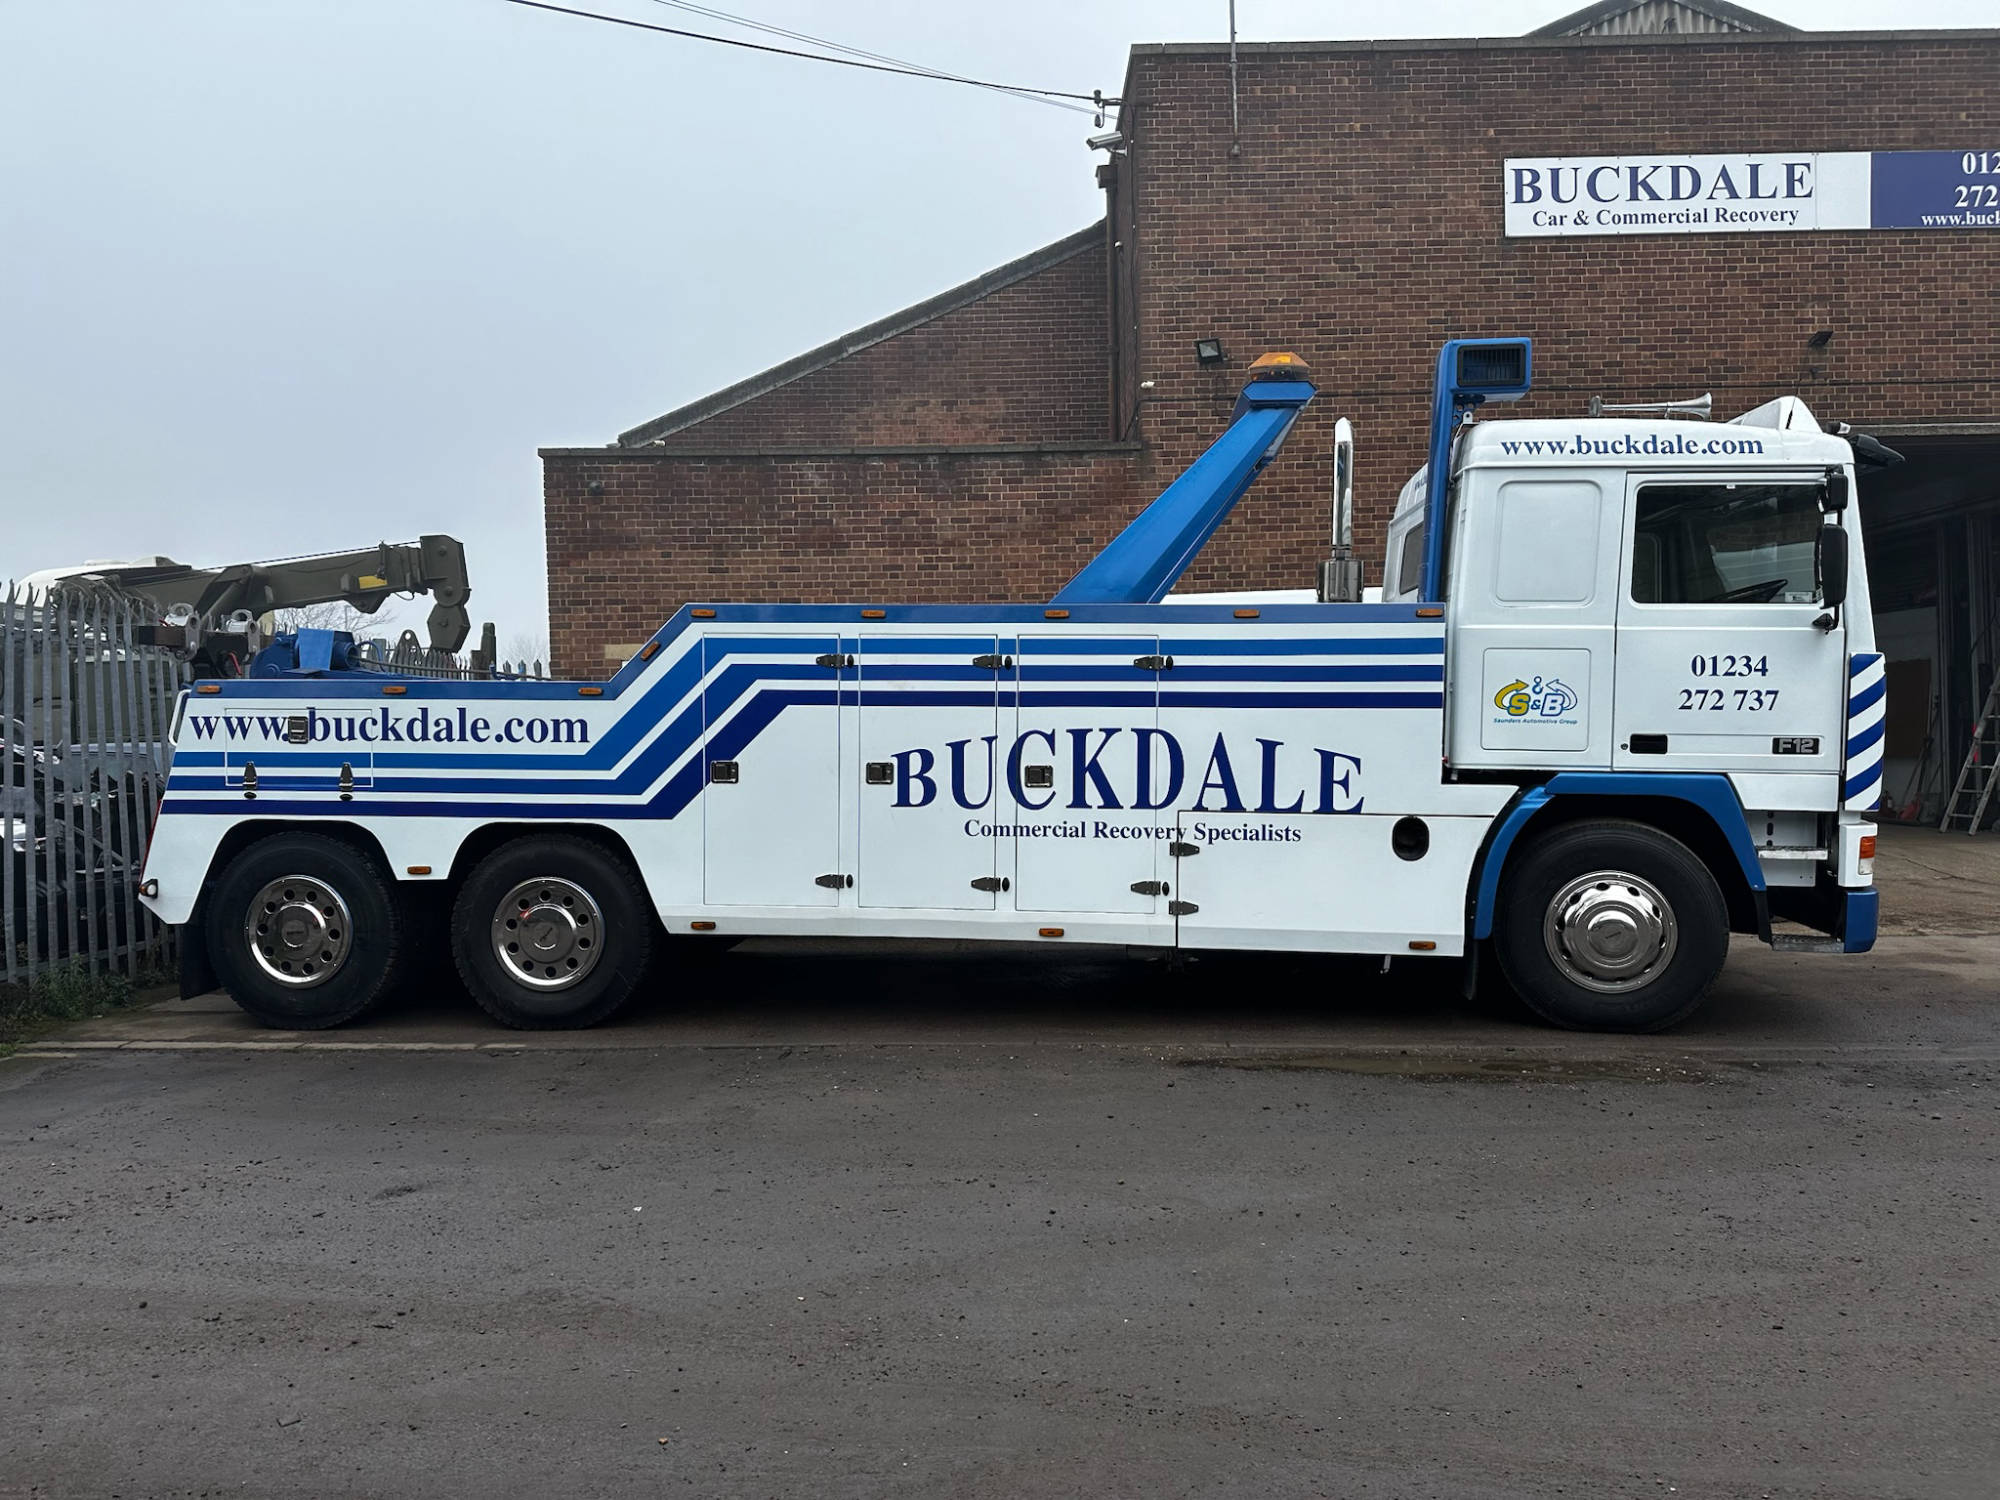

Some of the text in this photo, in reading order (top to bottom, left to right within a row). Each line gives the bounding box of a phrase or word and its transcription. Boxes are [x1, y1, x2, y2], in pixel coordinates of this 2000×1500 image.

[1509, 162, 1814, 204] BUCKDALE
[1954, 185, 1999, 207] 272
[1532, 206, 1800, 227] Car & Commercial Recovery
[1500, 434, 1764, 456] www.buckdale.com
[1691, 654, 1769, 677] 01234
[1678, 689, 1780, 711] 272 737
[190, 706, 590, 744] www.buckdale.com
[1778, 738, 1814, 753] F12
[890, 727, 1365, 815] BUCKDALE
[964, 819, 1302, 845] Commercial Recovery Specialists
